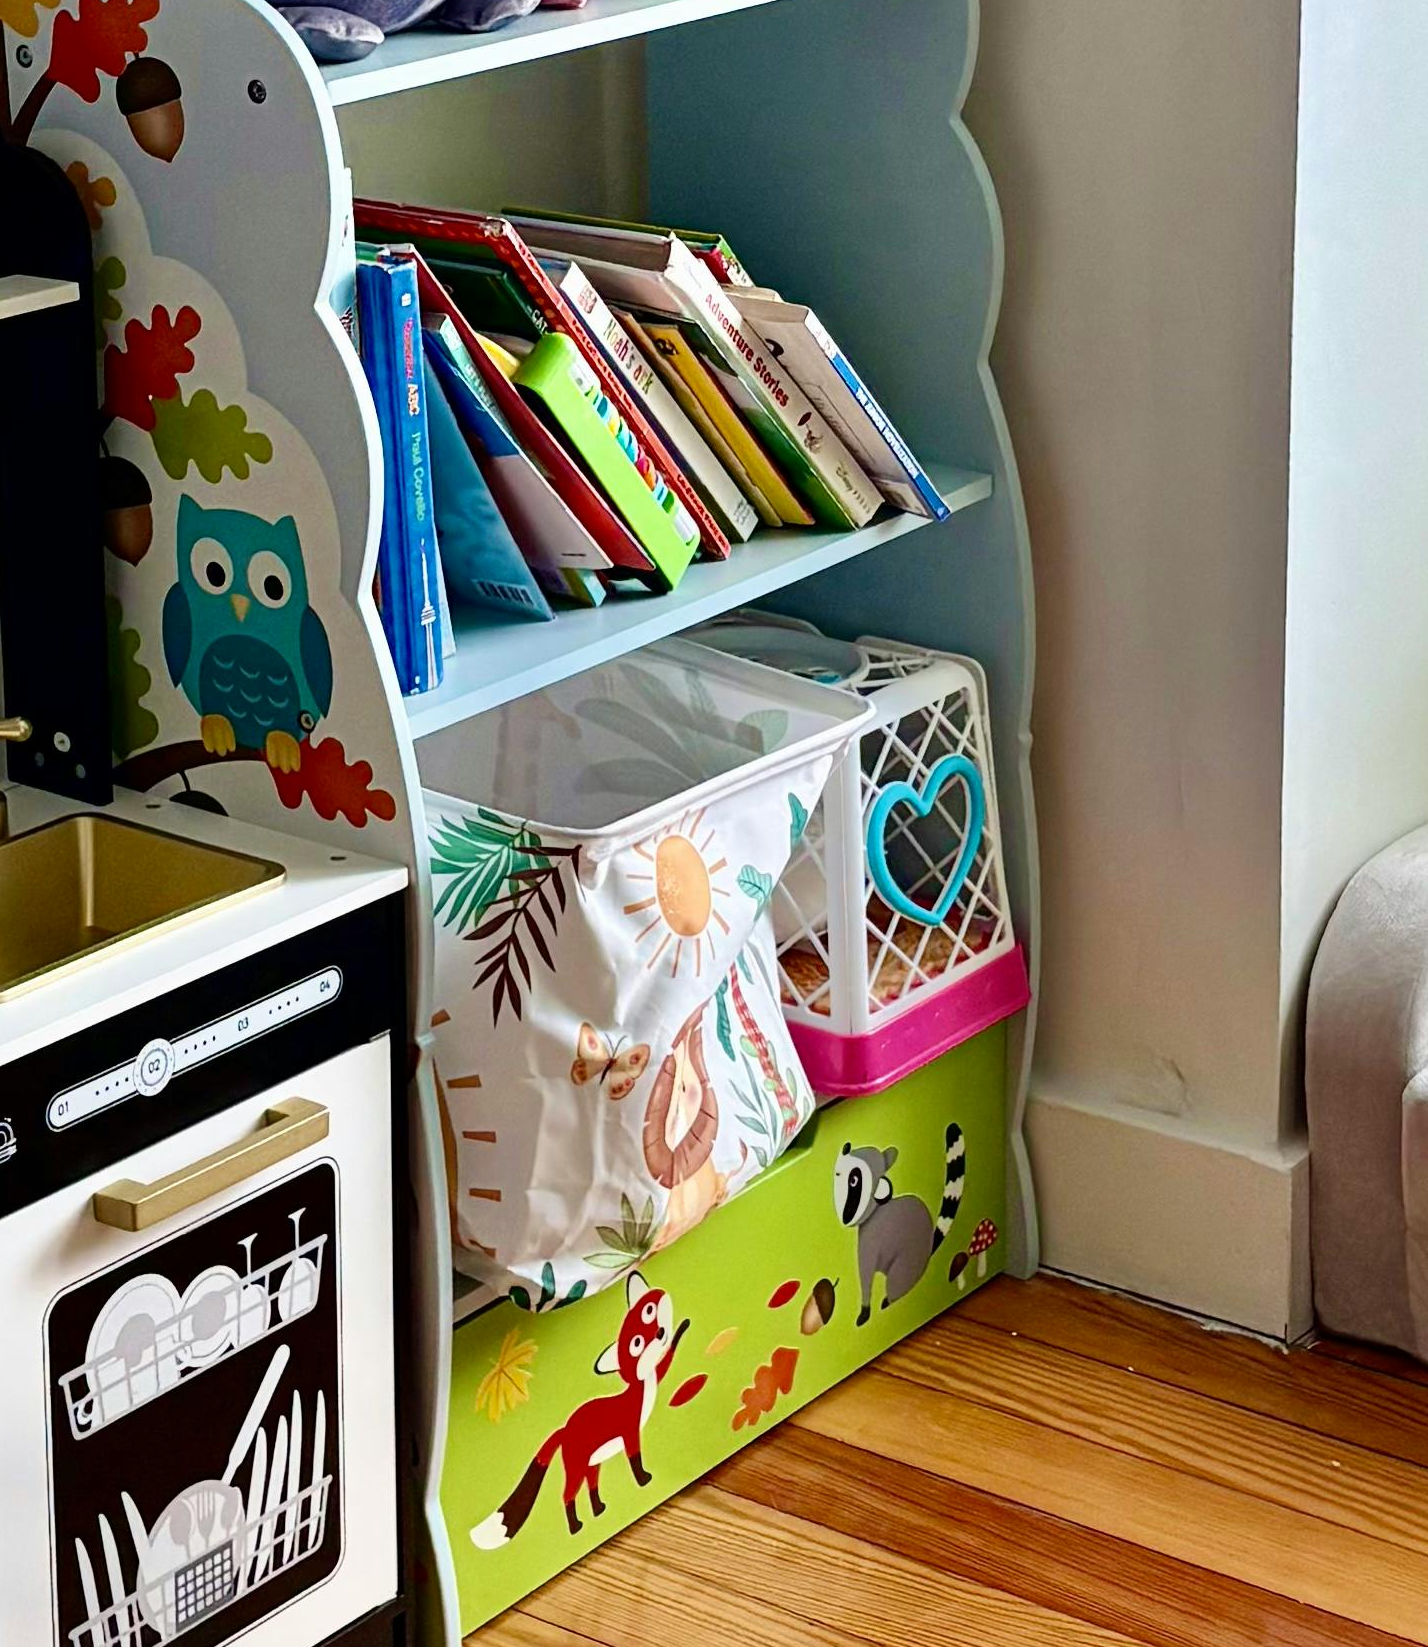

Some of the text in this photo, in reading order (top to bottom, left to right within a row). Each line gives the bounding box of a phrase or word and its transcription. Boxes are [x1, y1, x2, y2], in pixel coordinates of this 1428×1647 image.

[603, 318, 655, 395] Noah's ark
[705, 294, 790, 409] Adventure Stories
[57, 980, 331, 1116] 01 02 03 04
